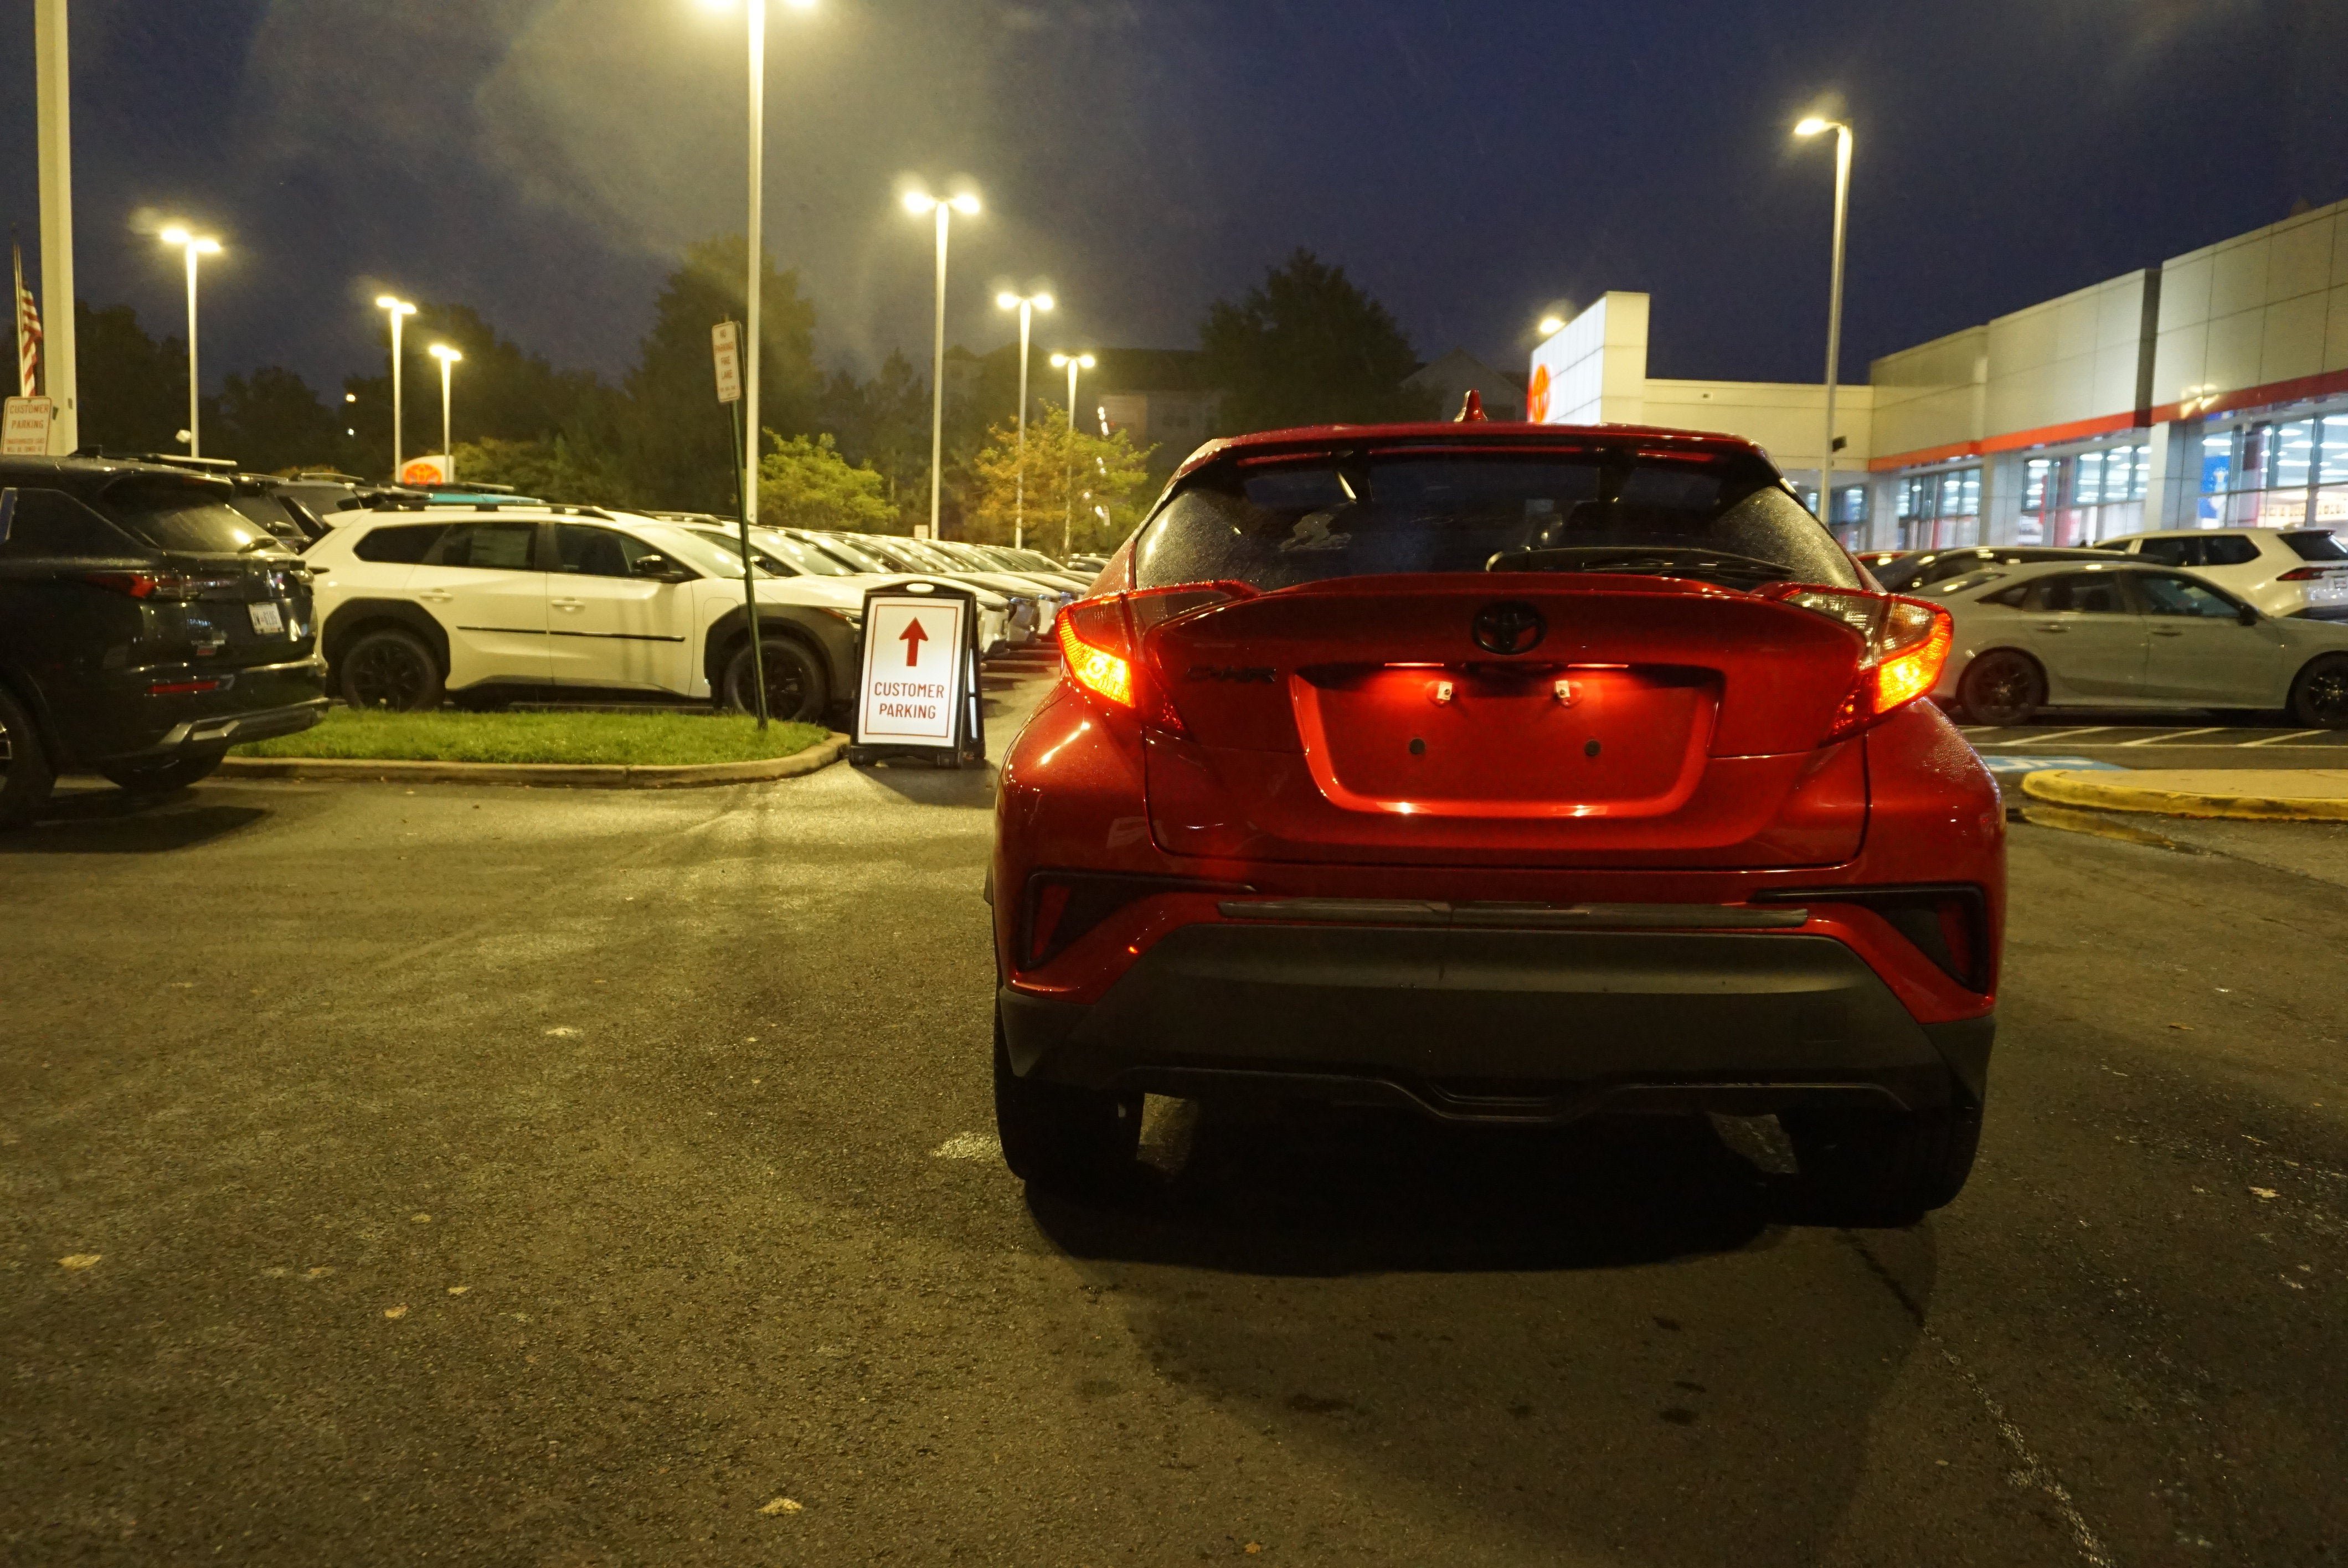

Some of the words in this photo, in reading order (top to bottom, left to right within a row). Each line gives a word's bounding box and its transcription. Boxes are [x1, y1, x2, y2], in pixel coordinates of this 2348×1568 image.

[9, 404, 49, 414] CUSTOMER
[11, 420, 43, 429] PARKING
[874, 682, 945, 698] CUSTOMER
[879, 703, 936, 719] PARKING
